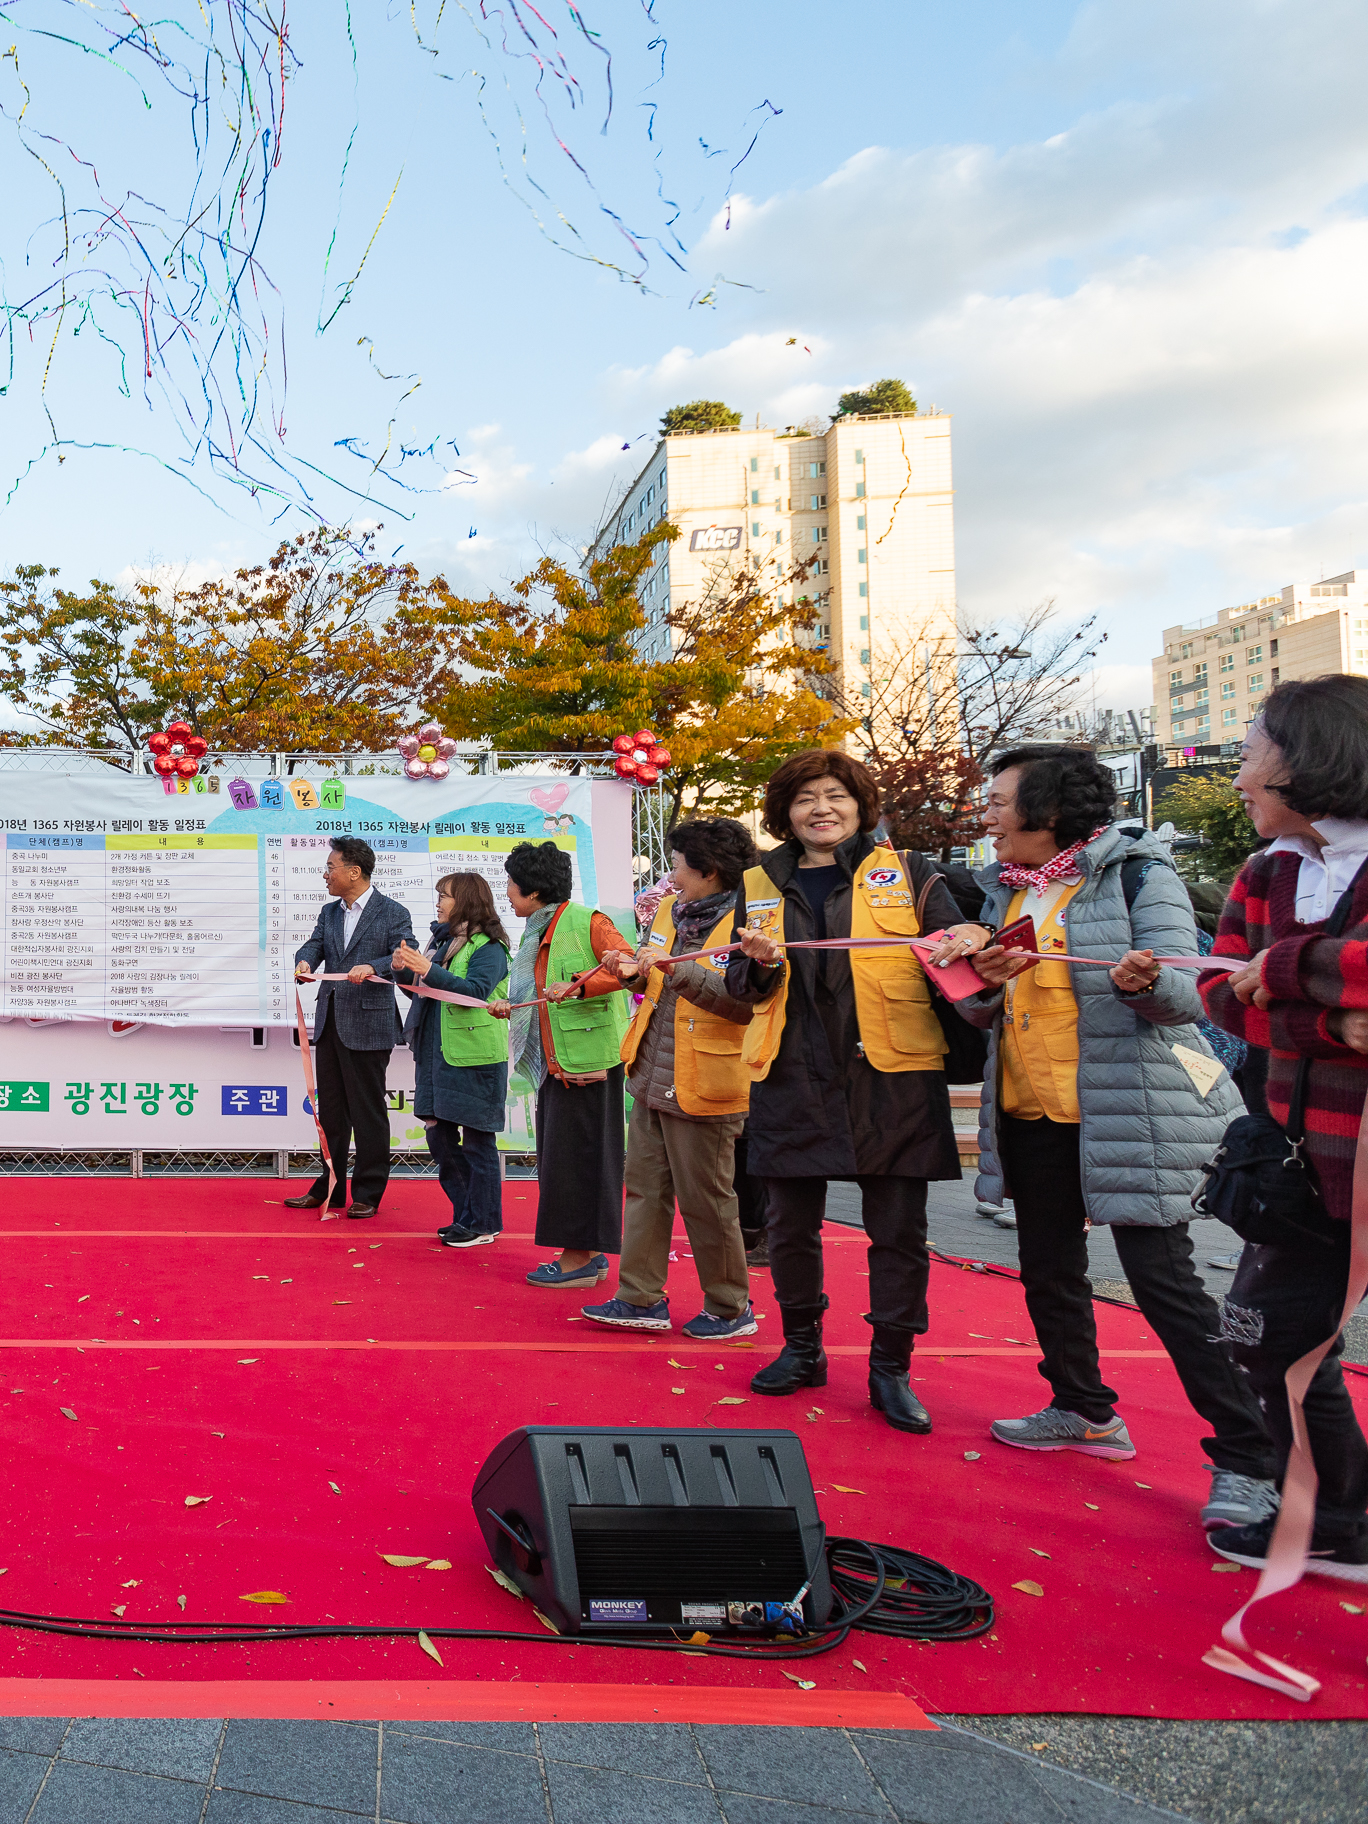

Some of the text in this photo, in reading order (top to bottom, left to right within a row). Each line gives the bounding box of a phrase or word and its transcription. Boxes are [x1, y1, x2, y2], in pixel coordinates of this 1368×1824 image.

[695, 524, 739, 549] KCC
[32, 819, 58, 830] 1365
[64, 819, 107, 832] 자원봉사
[111, 819, 143, 832] 릴레이
[148, 819, 169, 832] 활동
[175, 819, 207, 831] 일정표
[316, 821, 526, 834] 2018년 1365 자원봉사 릴레이 활동 일정표
[267, 838, 282, 846] 연번
[12, 865, 38, 873] 동일교회
[64, 1081, 199, 1116] 광진광장
[229, 1089, 280, 1113] 주관
